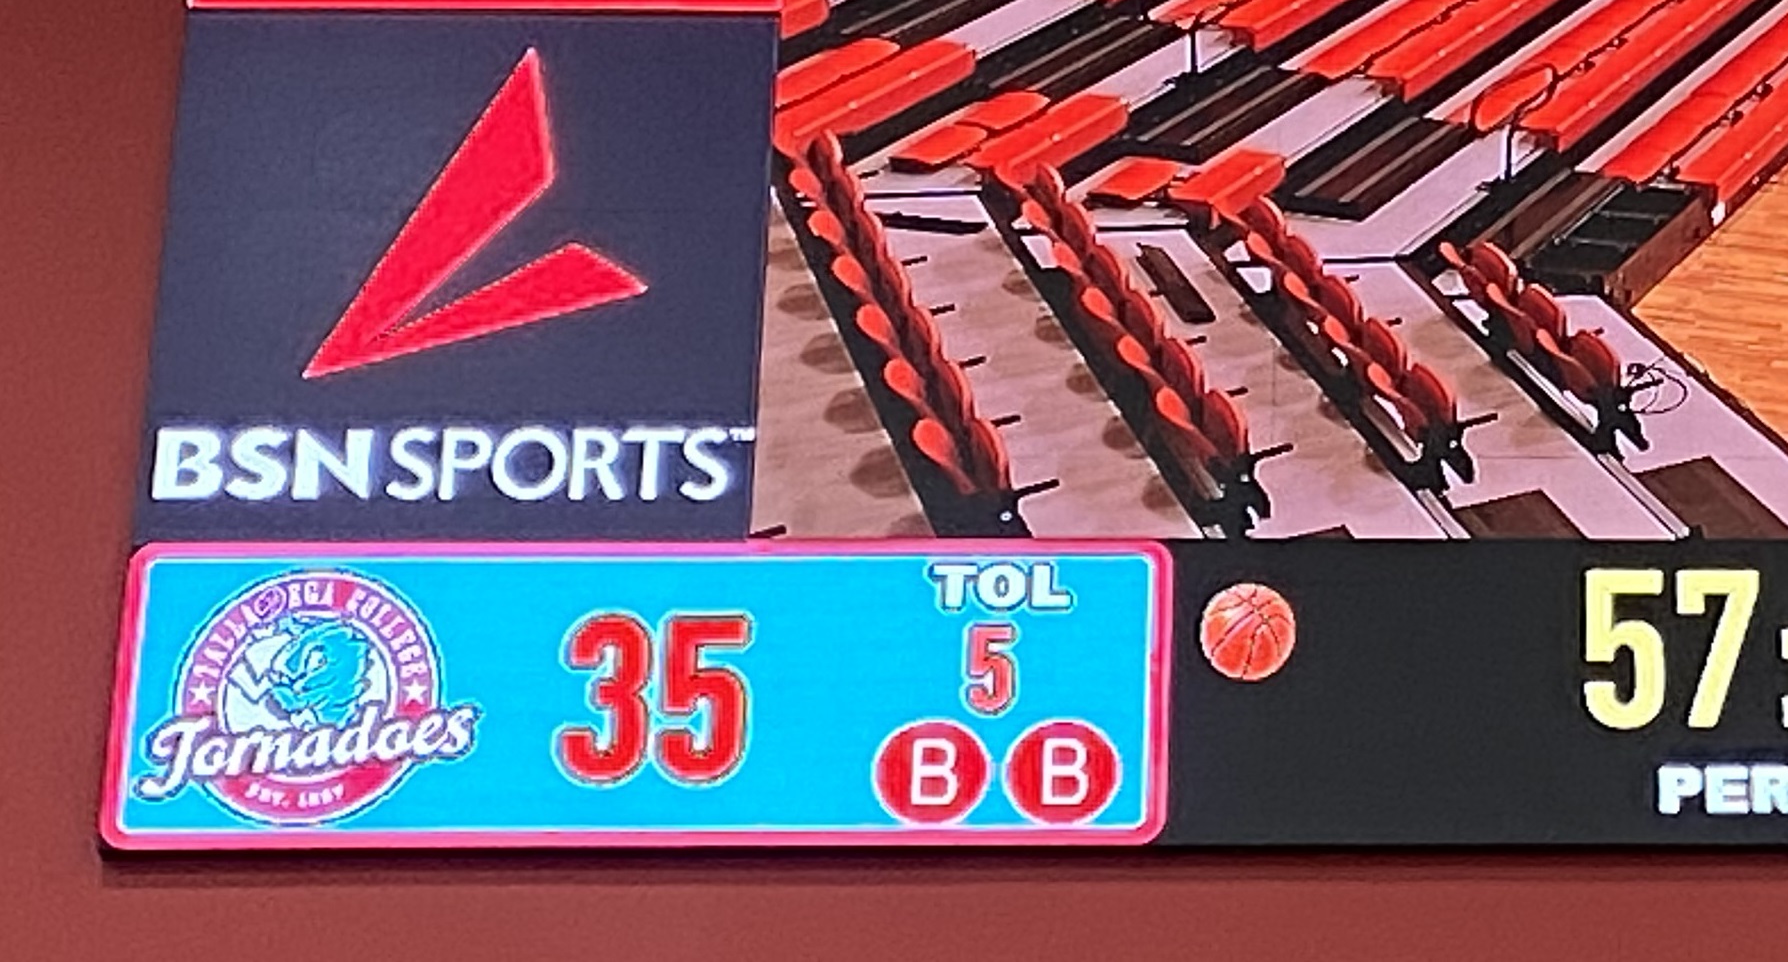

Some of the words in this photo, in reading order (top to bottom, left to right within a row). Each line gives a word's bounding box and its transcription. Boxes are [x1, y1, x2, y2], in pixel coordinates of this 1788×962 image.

[151, 427, 374, 501] BSN
[932, 564, 1072, 608] TOL
[557, 613, 752, 783] 35
[964, 623, 1016, 713] 5
[136, 704, 482, 798] Tornadoes
[910, 738, 958, 806] B
[1040, 738, 1090, 806] B
